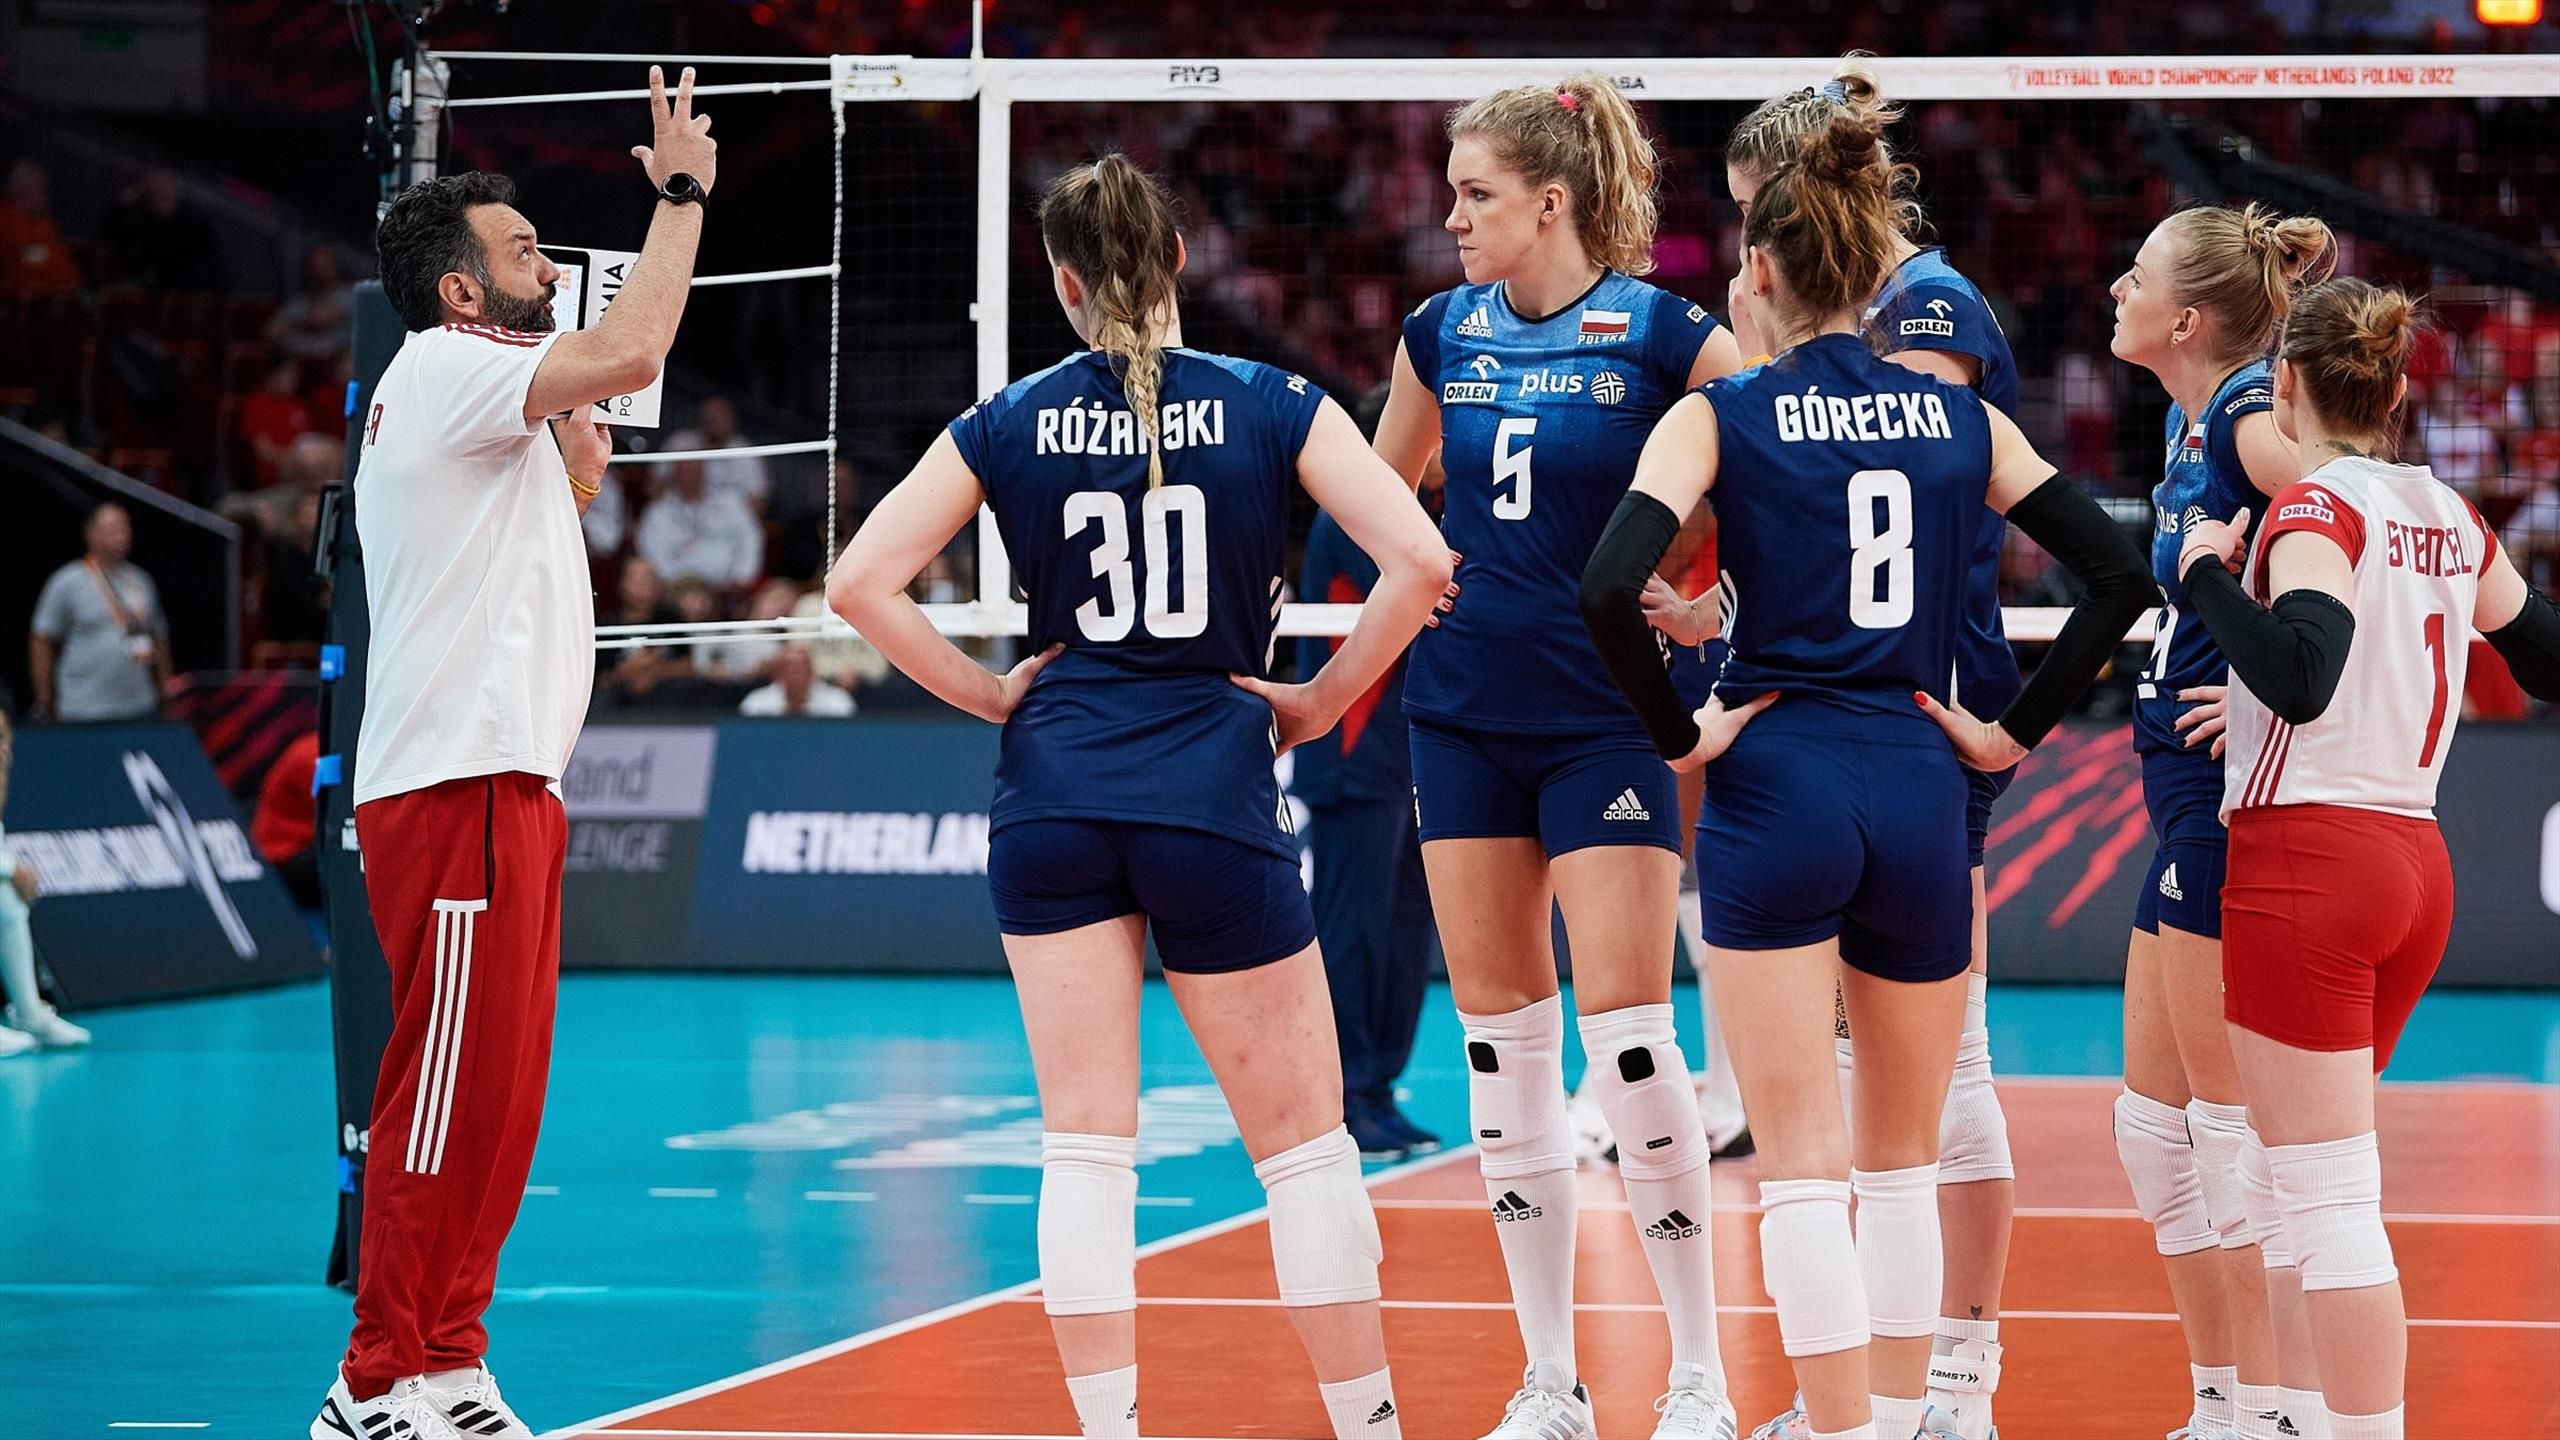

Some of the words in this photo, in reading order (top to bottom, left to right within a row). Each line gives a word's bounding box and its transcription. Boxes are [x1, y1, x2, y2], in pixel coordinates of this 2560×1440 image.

[2025, 68, 2100, 85] VOLLEYBALL
[2106, 67, 2155, 85] WORLD
[2159, 67, 2258, 85] CHAMPIONSHIP
[2263, 67, 2356, 84] NETHERLANDS
[2361, 67, 2413, 84] POLAND
[2418, 67, 2456, 84] 2022
[1902, 320, 1951, 334] ORLEN
[1445, 384, 1493, 400] ORLEN
[1518, 368, 1585, 397] plus
[1774, 385, 1953, 443] GÓRECKA
[1492, 417, 1539, 521] 5
[2281, 505, 2332, 521] ORLEN
[1063, 483, 1209, 642] 30
[1847, 469, 1915, 630] 8
[2417, 613, 2449, 769] 1
[1602, 807, 1651, 821] adidas
[1645, 1223, 1703, 1241] adidas
